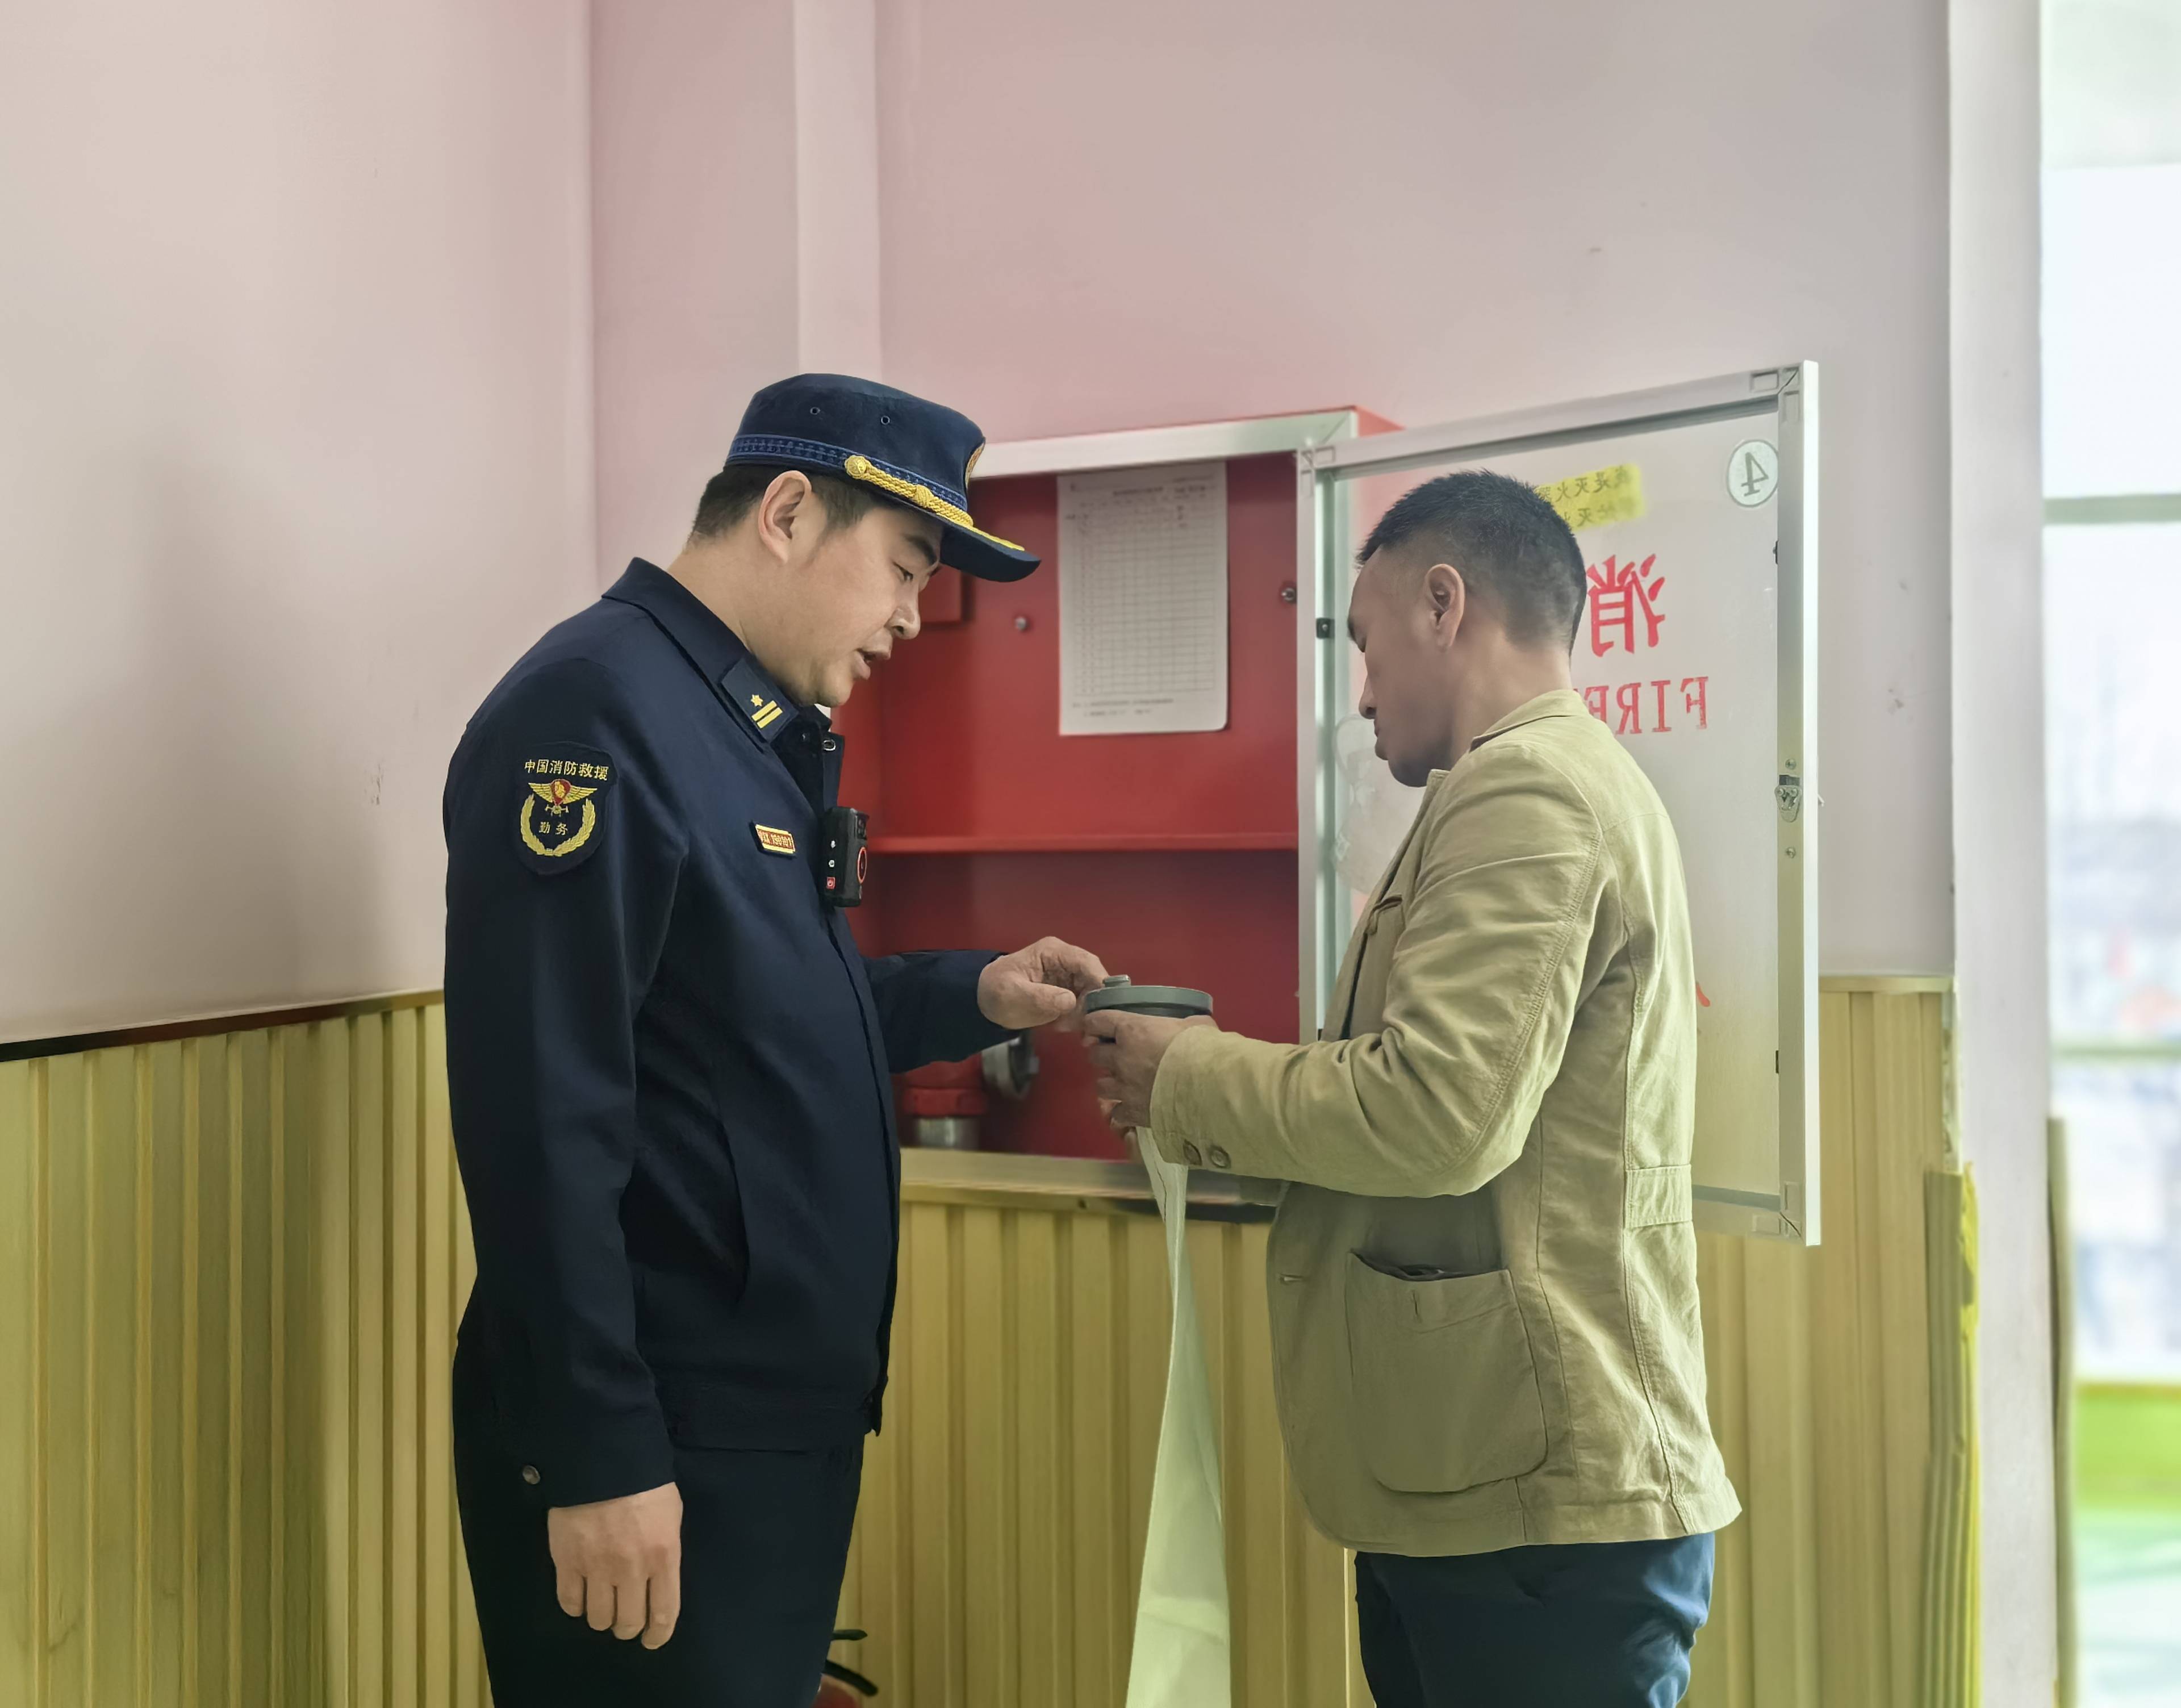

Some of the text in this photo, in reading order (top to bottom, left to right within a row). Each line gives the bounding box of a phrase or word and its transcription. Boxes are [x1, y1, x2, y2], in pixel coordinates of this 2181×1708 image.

[524, 759, 609, 781] 中国消防救援
